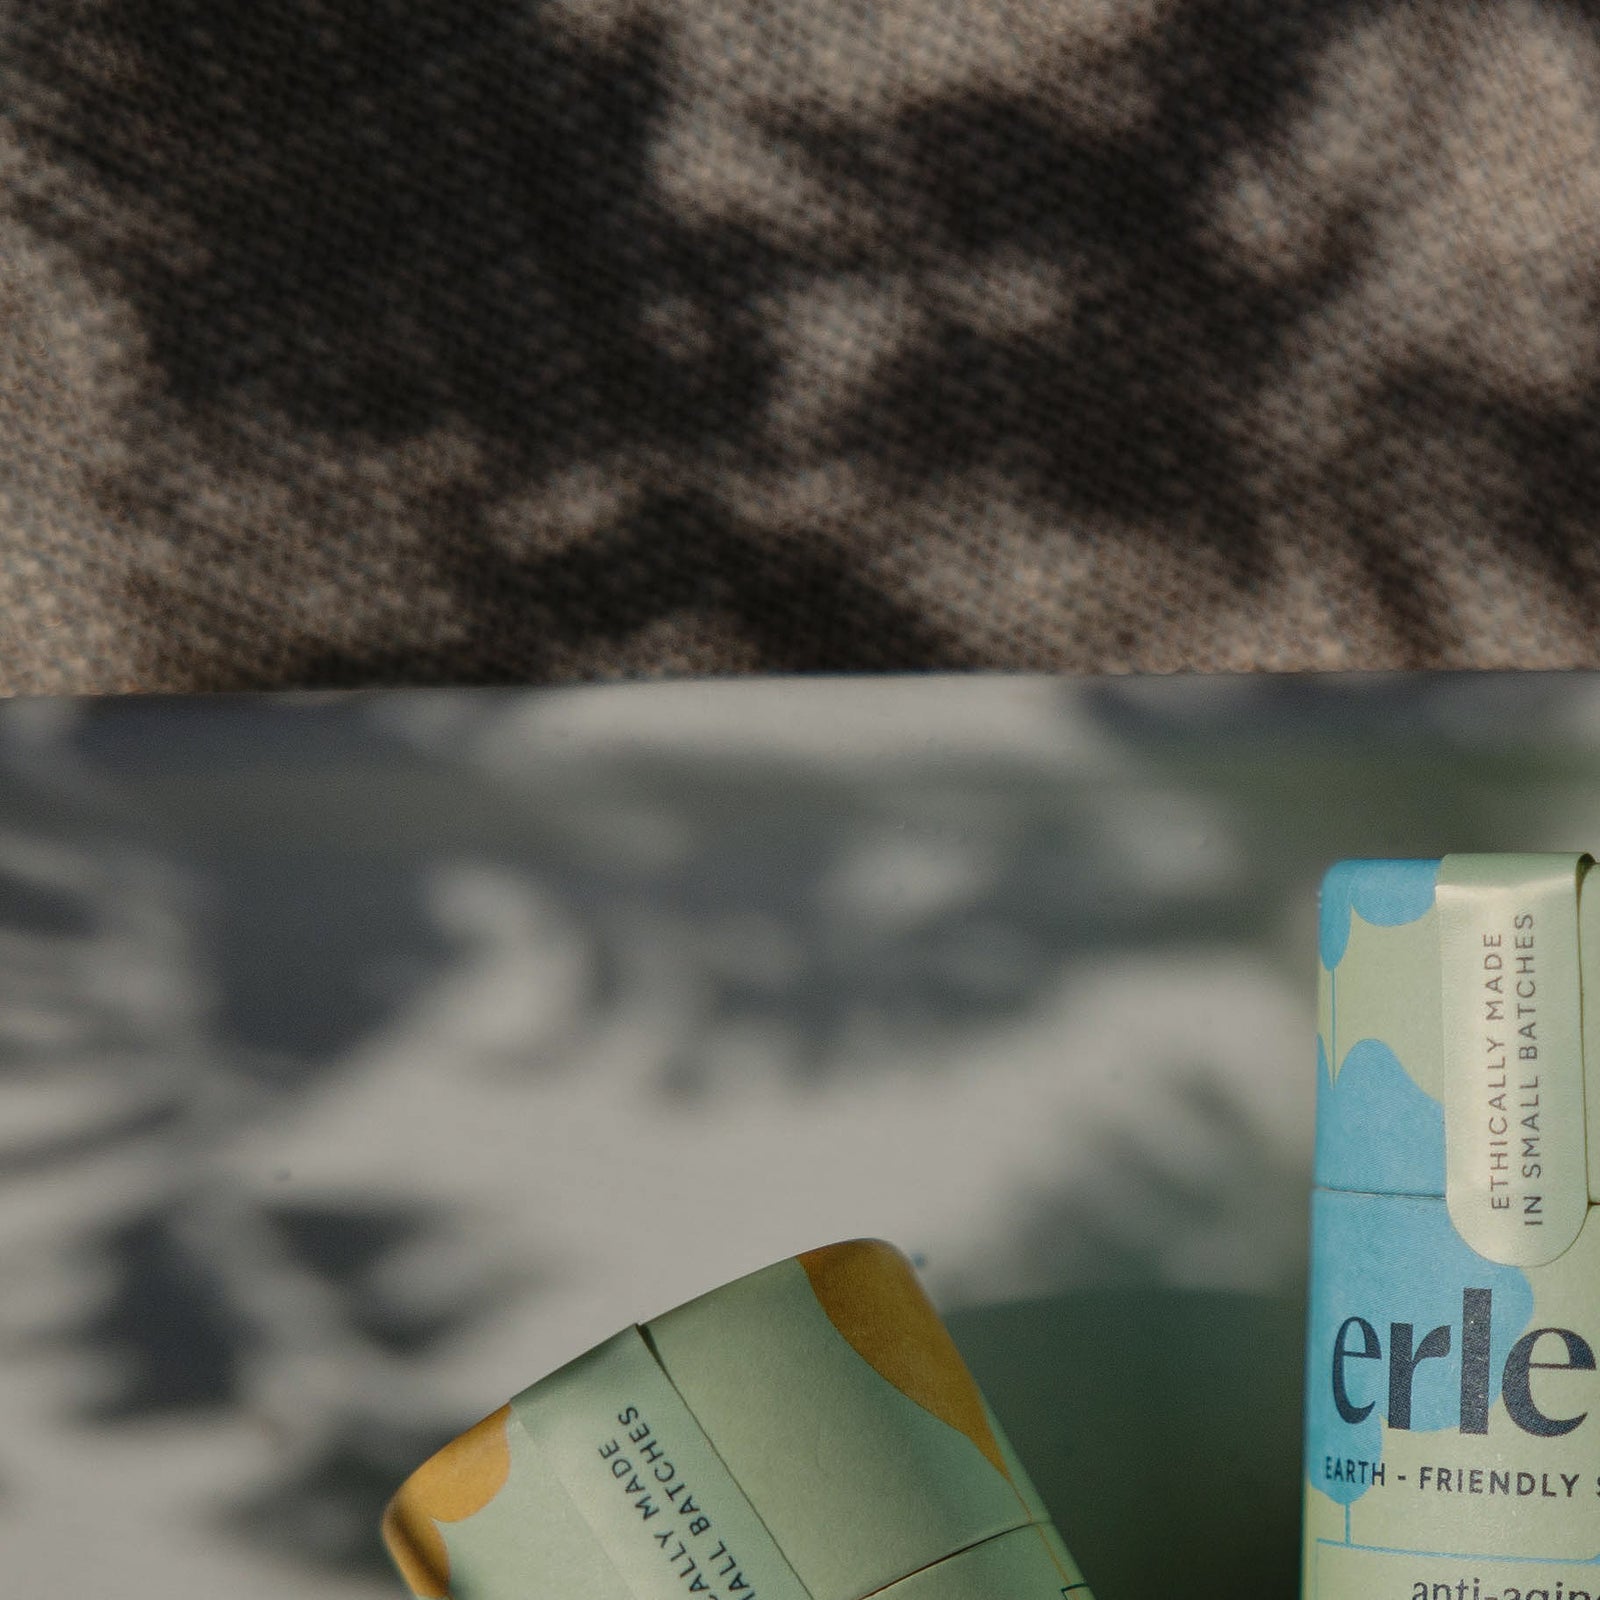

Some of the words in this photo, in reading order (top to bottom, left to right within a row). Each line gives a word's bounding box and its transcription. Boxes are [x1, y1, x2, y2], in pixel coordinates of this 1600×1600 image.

[1483, 935, 1504, 1020] MADE
[1515, 915, 1537, 1060] BATCHES
[1487, 1038, 1511, 1210] ETHICALLY
[1520, 1076, 1541, 1179] SMALL
[1523, 1195, 1543, 1226] IN
[598, 1439, 660, 1521] MADE
[618, 1406, 711, 1537] BATCHES
[1326, 1456, 1385, 1486] EARTH
[1420, 1467, 1579, 1497] FRIENDLY
